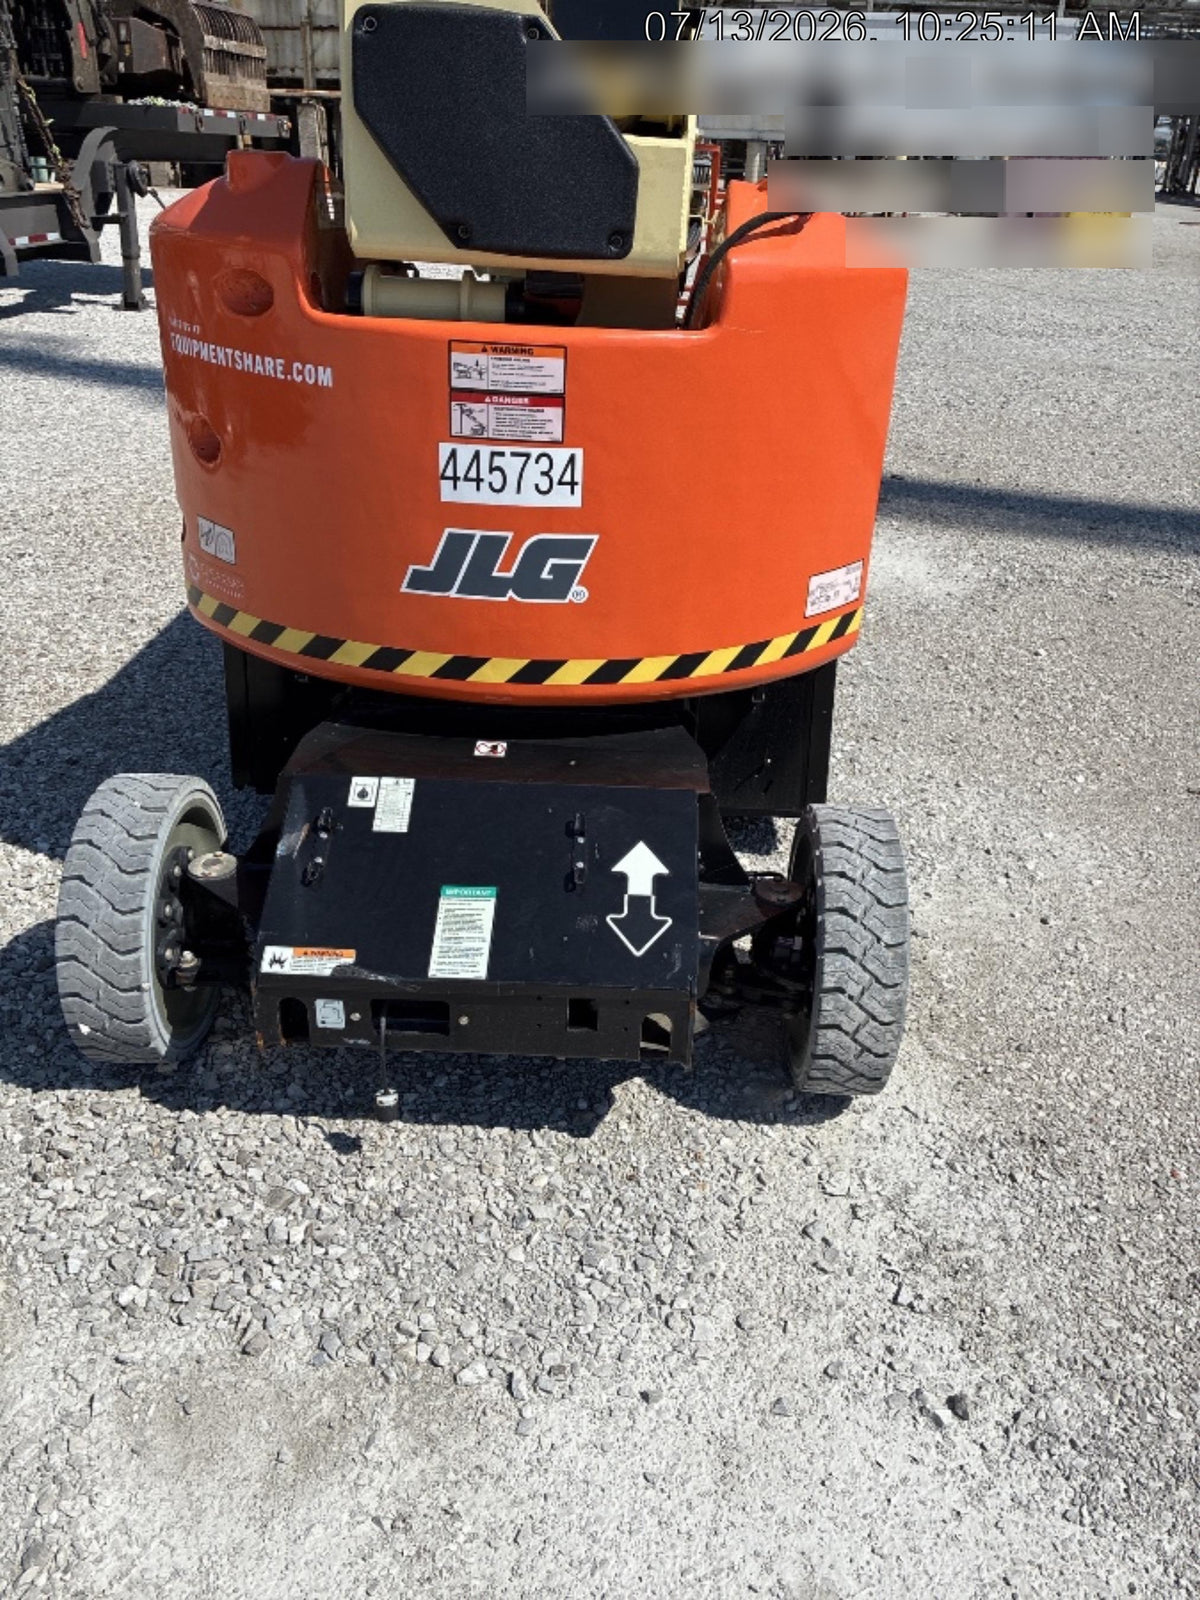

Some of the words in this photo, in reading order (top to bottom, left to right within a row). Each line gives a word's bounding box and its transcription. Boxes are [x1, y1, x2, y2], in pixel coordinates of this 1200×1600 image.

[490, 345, 534, 355] WARNING
[491, 396, 530, 404] DANGER
[440, 448, 579, 496] 445734
[400, 528, 599, 603] JLG
